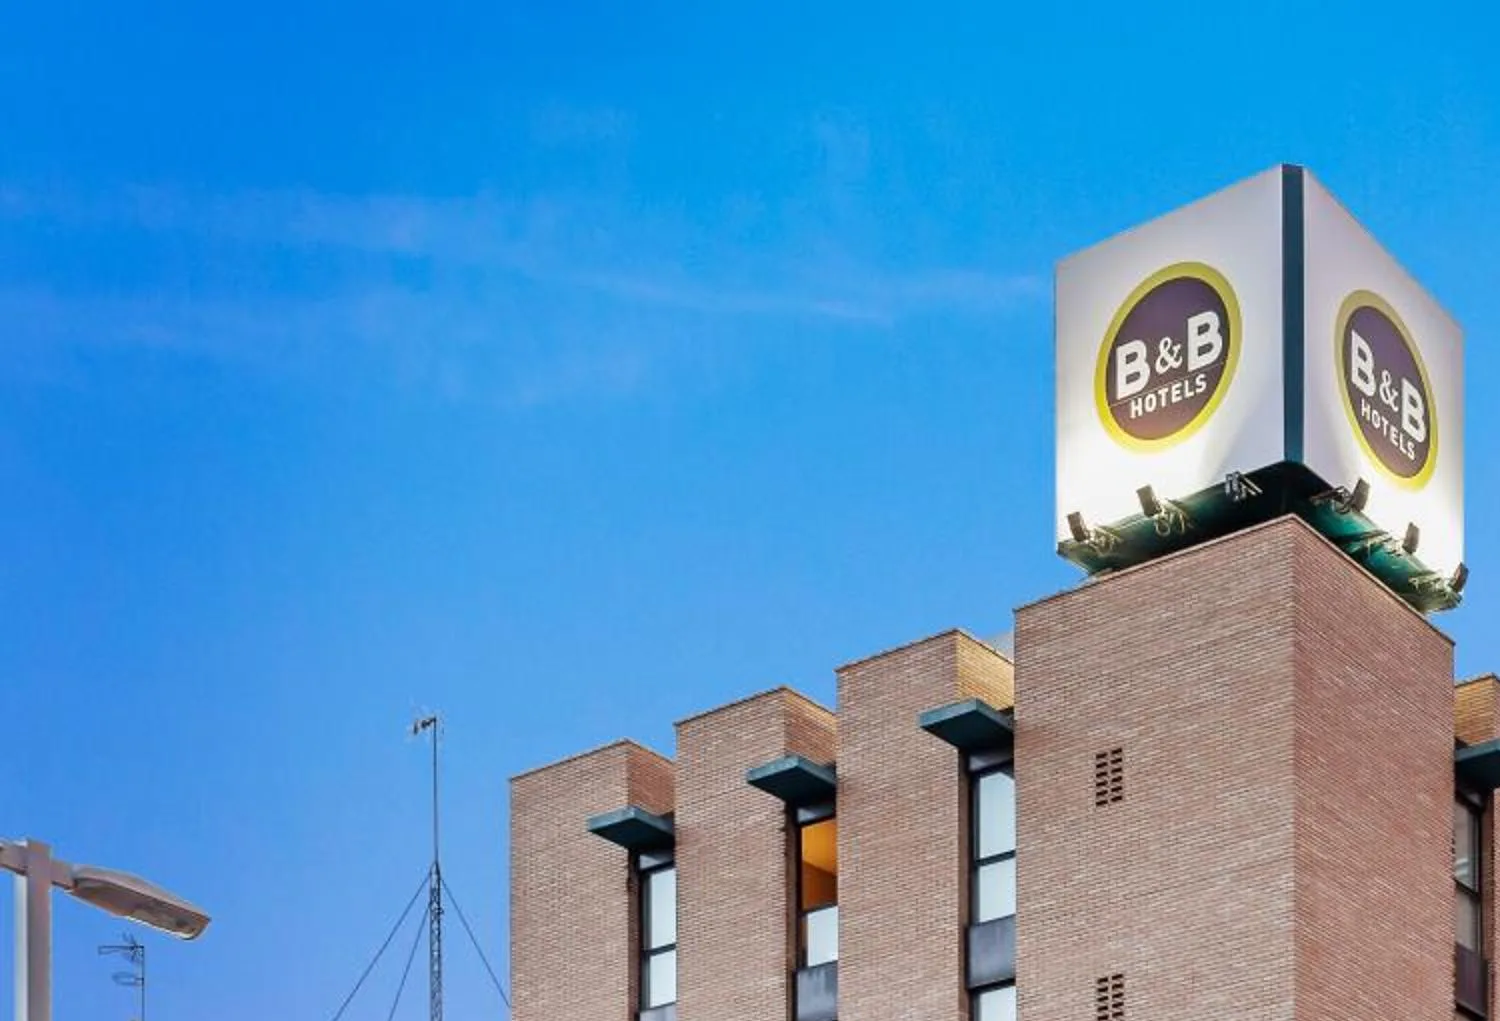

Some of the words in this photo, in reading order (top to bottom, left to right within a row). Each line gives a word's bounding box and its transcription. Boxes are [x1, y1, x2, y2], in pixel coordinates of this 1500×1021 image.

[1115, 310, 1223, 399] B&B
[1350, 330, 1426, 443] B&B
[1130, 374, 1207, 418] HOTELS
[1361, 399, 1416, 461] HOTELS
